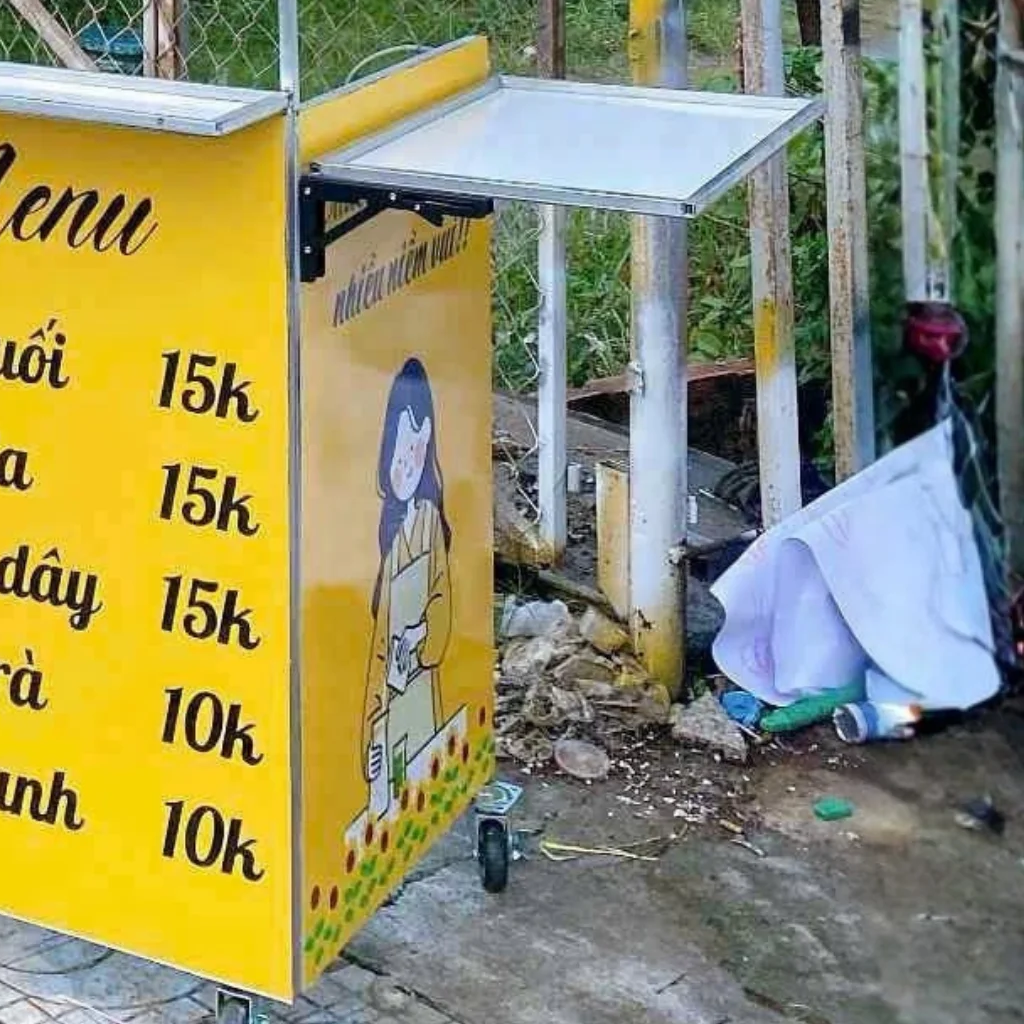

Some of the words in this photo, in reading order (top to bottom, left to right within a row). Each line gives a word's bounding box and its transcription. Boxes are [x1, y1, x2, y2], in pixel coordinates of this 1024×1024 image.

[158, 350, 259, 422] 15k
[159, 464, 260, 536] 15k
[161, 576, 261, 649] 15k
[162, 687, 263, 765] 10k
[163, 801, 264, 881] 10k
